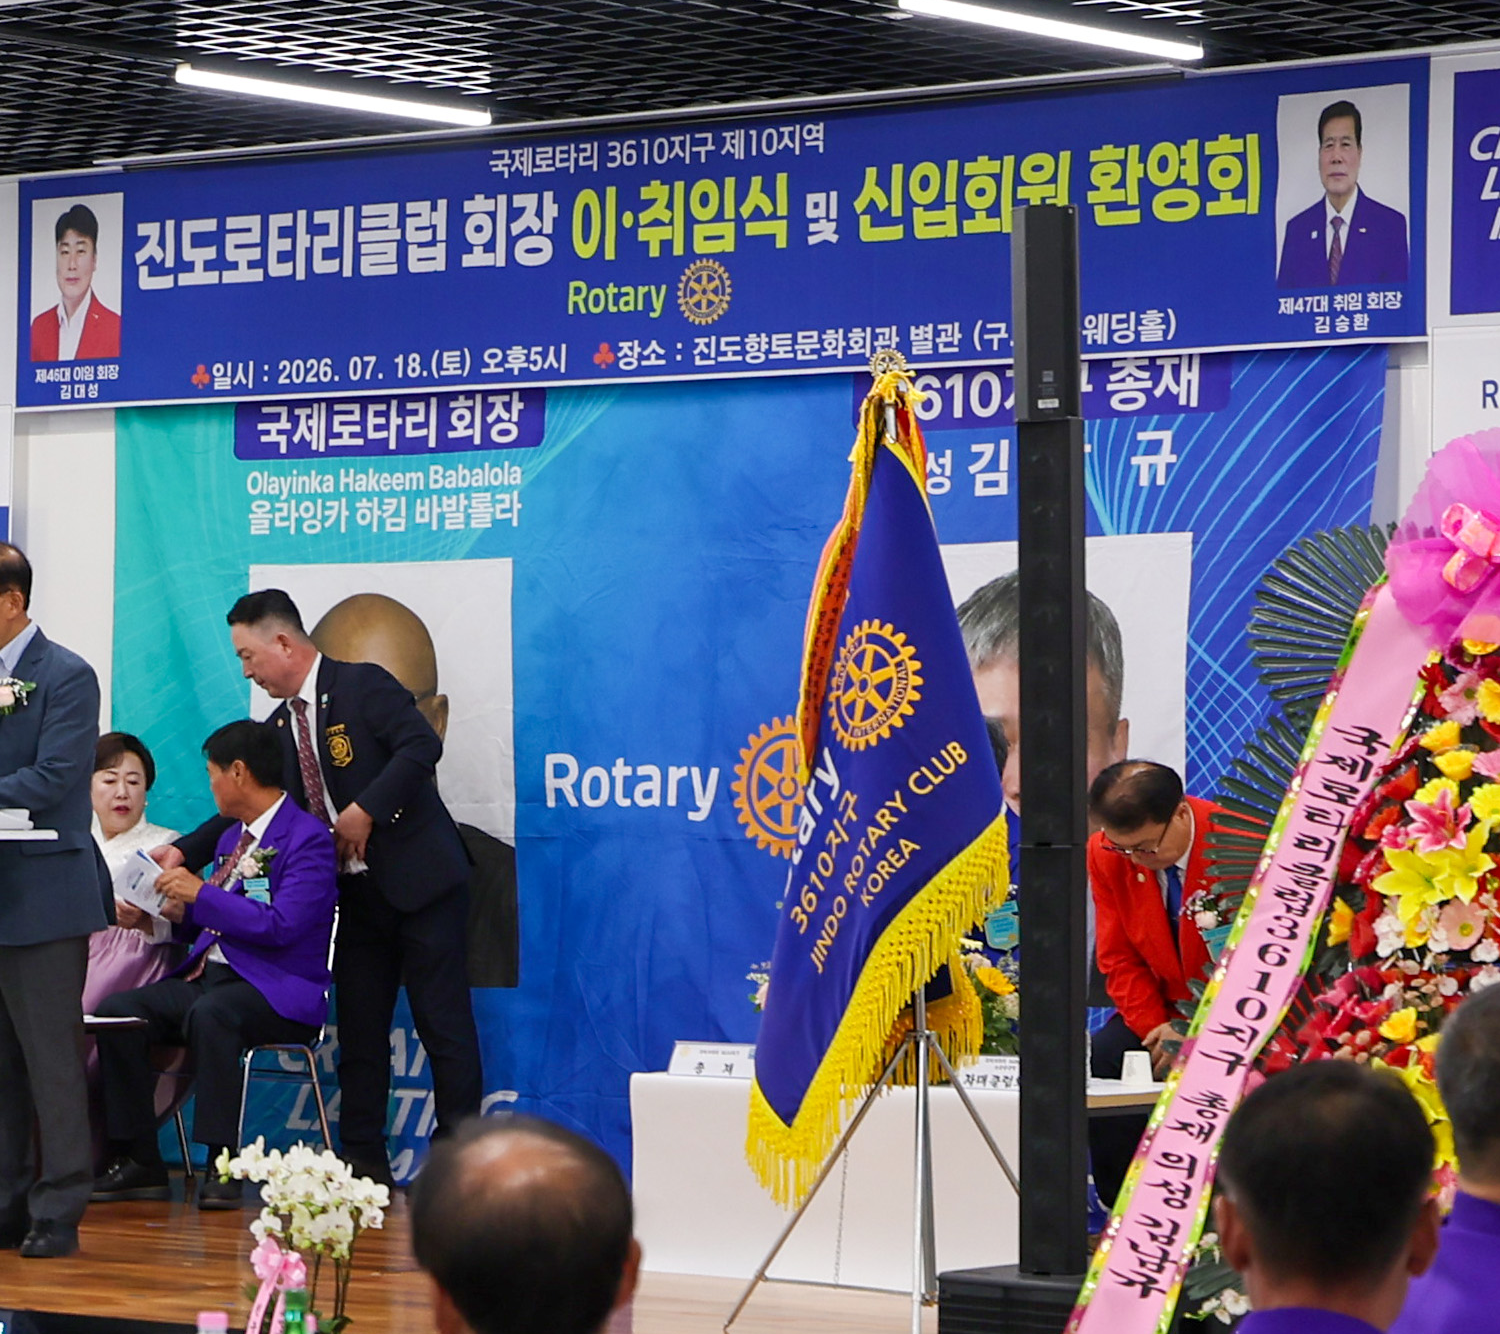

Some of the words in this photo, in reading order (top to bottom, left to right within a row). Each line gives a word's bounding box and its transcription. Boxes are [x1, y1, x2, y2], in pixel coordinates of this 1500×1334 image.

[488, 142, 599, 179] 국제로타리
[606, 132, 716, 169] 3610지구
[721, 122, 826, 160] 제10지역
[133, 199, 449, 291] 진도로타리클럽
[461, 190, 558, 268] 회장
[571, 172, 789, 260] 이·취임식
[804, 190, 840, 246] 및
[1087, 132, 1261, 227] 환영회
[566, 279, 668, 320] Rotary
[1277, 294, 1329, 315] 제47대
[1333, 292, 1362, 312] 취임
[1366, 290, 1403, 310] 회장
[34, 367, 71, 384] 제46대
[73, 365, 94, 381] 이임
[96, 364, 120, 380] 회장
[211, 360, 255, 391] 일시
[277, 358, 340, 385] 2026.
[349, 355, 384, 381] 07.
[480, 343, 568, 375] 오후5시
[616, 338, 667, 371] 장소
[692, 325, 900, 365] 진도향토문화회관
[909, 321, 962, 355] 별관
[1106, 354, 1201, 412] 총재
[256, 398, 438, 455] 국제로타리
[448, 390, 525, 446] 회장
[246, 469, 334, 501] Olayinka
[339, 466, 425, 495] Hakeem
[428, 460, 522, 490] Babalola
[248, 497, 350, 536] 올라잉카
[355, 494, 407, 534] 하킴
[415, 490, 522, 531] 바발롤라
[544, 752, 720, 822] Rotary
[790, 790, 859, 935] 3610지구
[810, 895, 848, 974] JINDO
[843, 790, 909, 895] ROTARY
[907, 740, 969, 796] CLUB
[859, 837, 922, 909] KOREA
[1166, 1089, 1231, 1145] 총재
[1144, 1152, 1199, 1210] 의성
